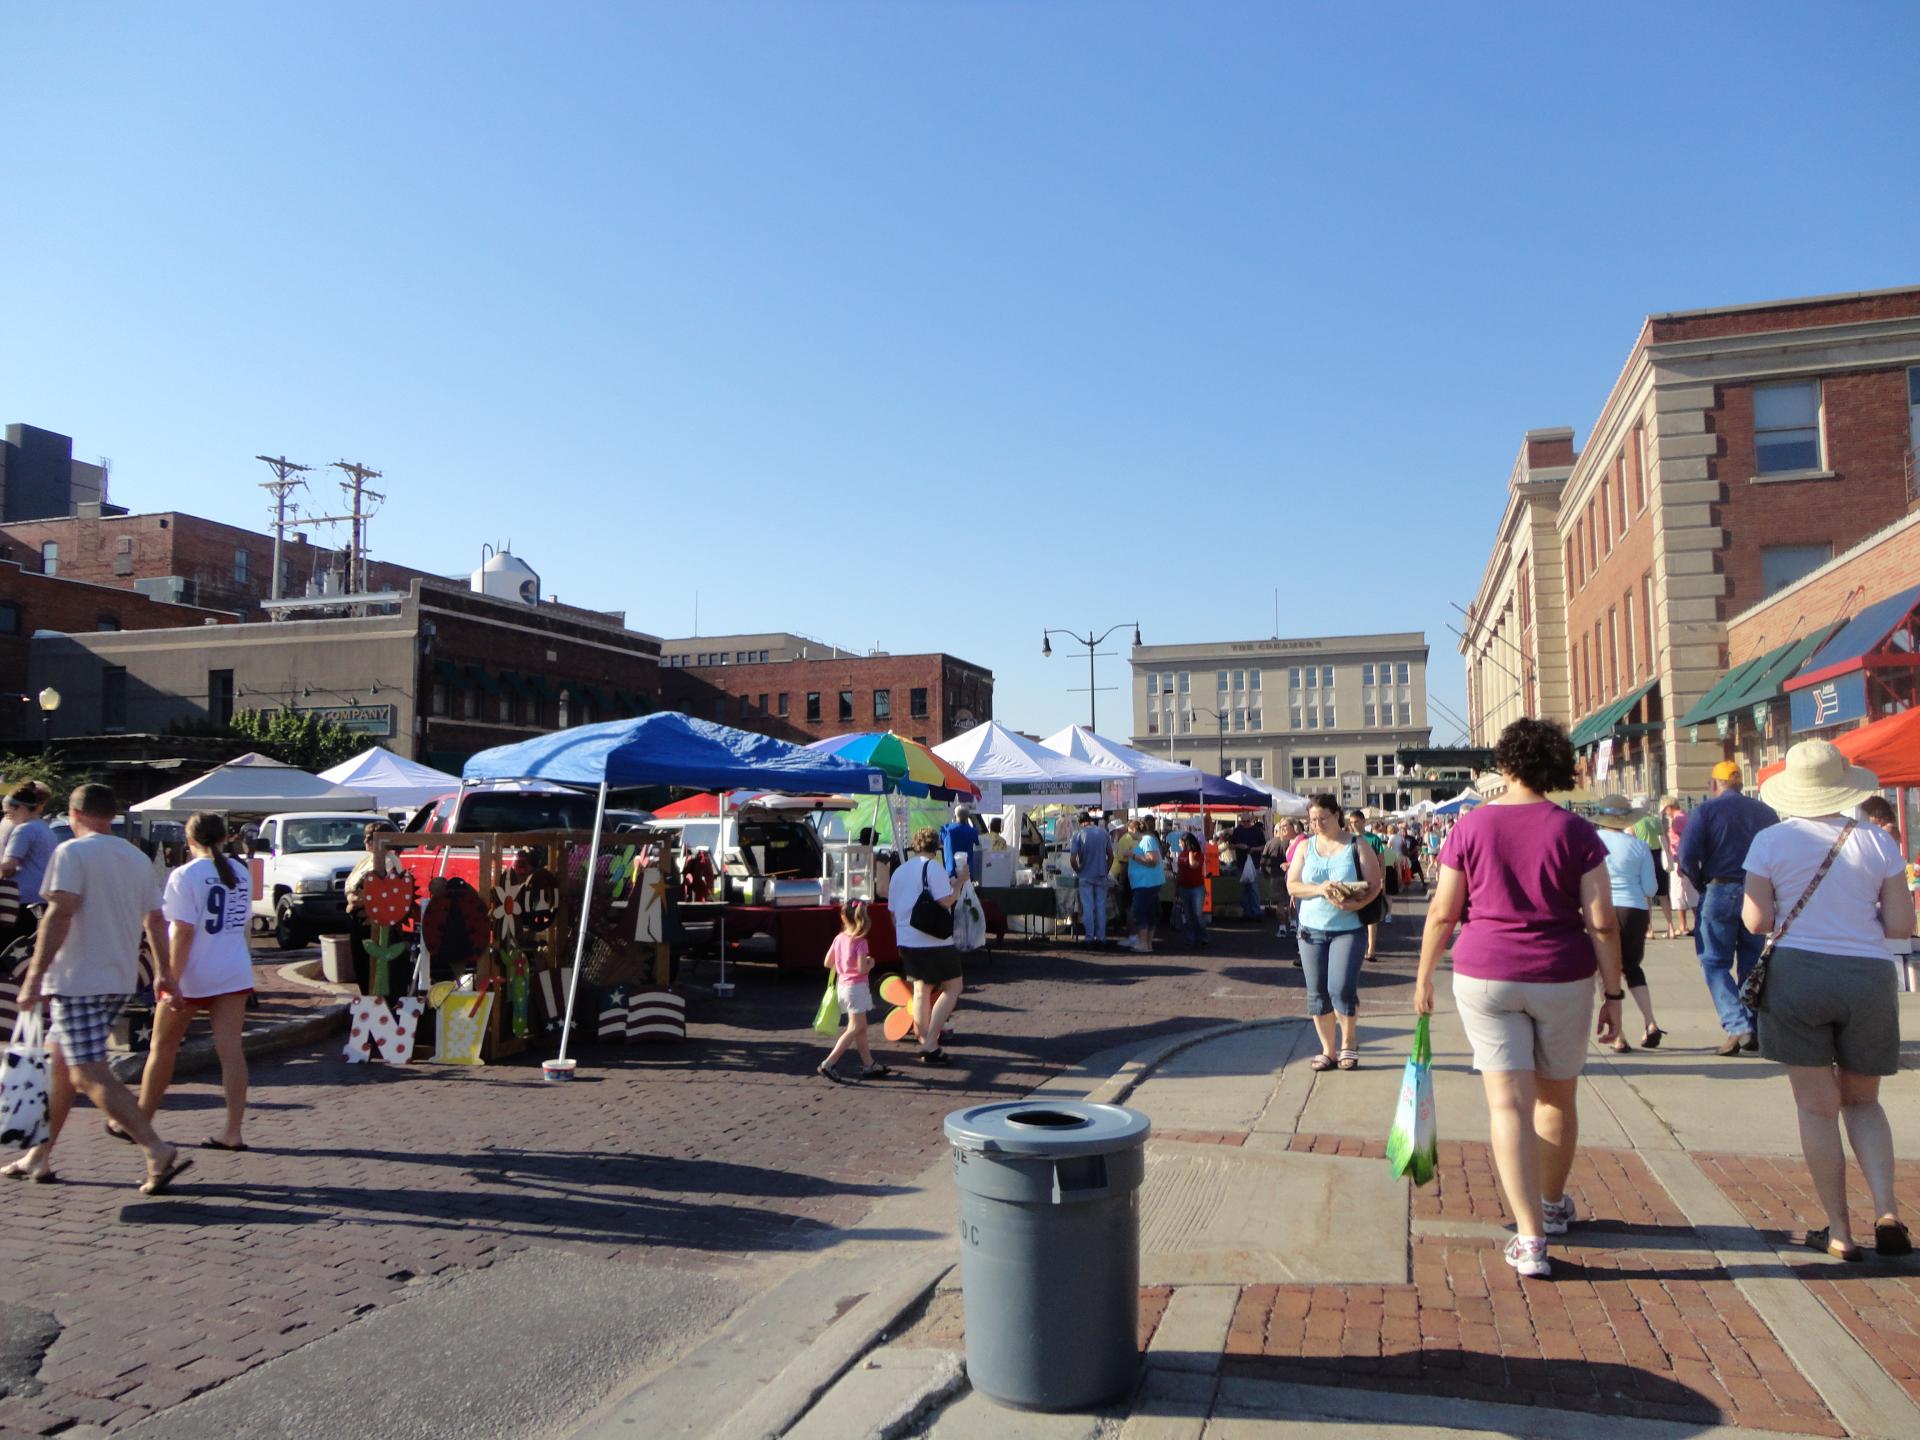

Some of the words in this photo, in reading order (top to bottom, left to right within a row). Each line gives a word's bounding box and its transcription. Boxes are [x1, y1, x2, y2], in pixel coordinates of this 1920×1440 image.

[1258, 641, 1322, 651] CREAMERY
[325, 708, 388, 720] COMPANY
[205, 885, 226, 935] 9
